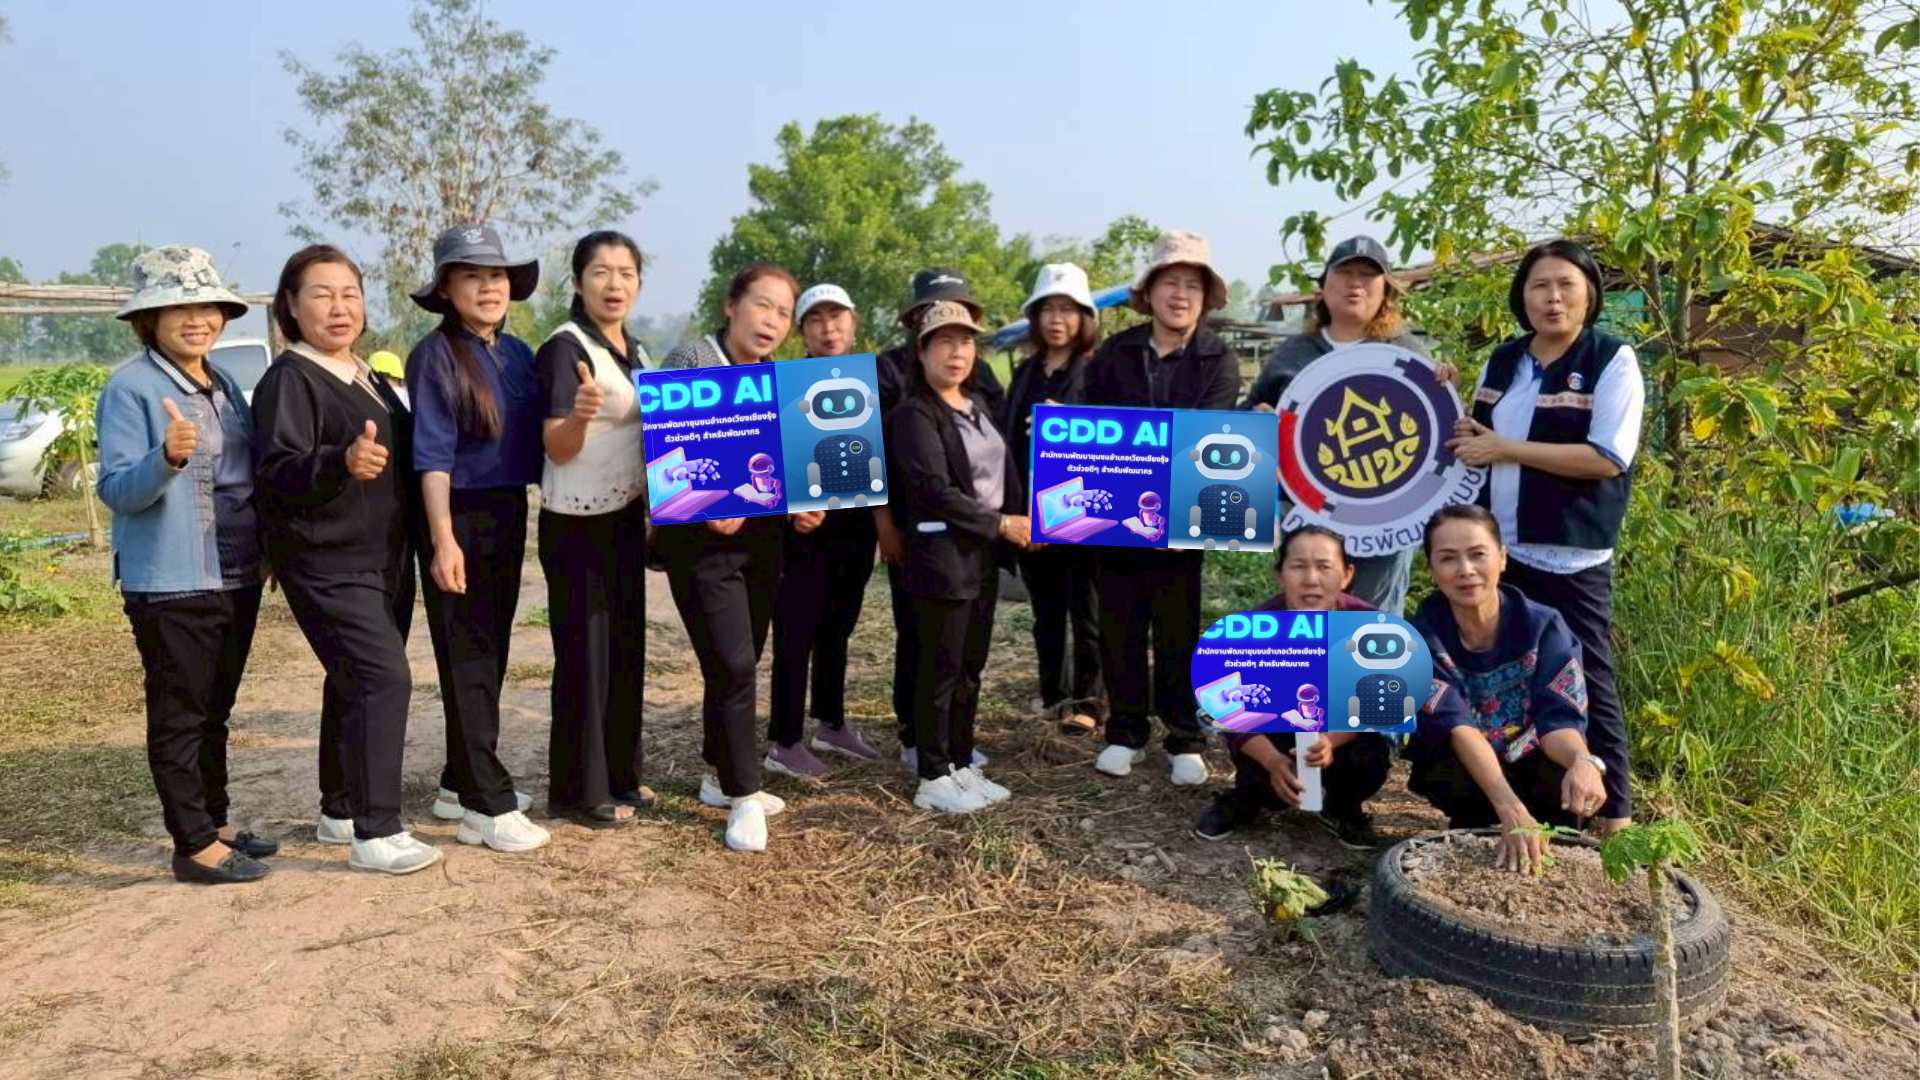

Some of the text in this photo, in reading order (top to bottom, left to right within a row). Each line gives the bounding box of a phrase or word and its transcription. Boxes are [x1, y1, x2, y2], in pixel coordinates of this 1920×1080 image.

[639, 374, 772, 413] CDD AI
[642, 411, 777, 431] นักงานพัฒนาชุมชนอำเภอเวียงเชียงรุ้ง
[1042, 417, 1168, 446] CDD AI
[703, 428, 760, 440] สำหรับพัฒนากร
[1288, 614, 1323, 639] AI
